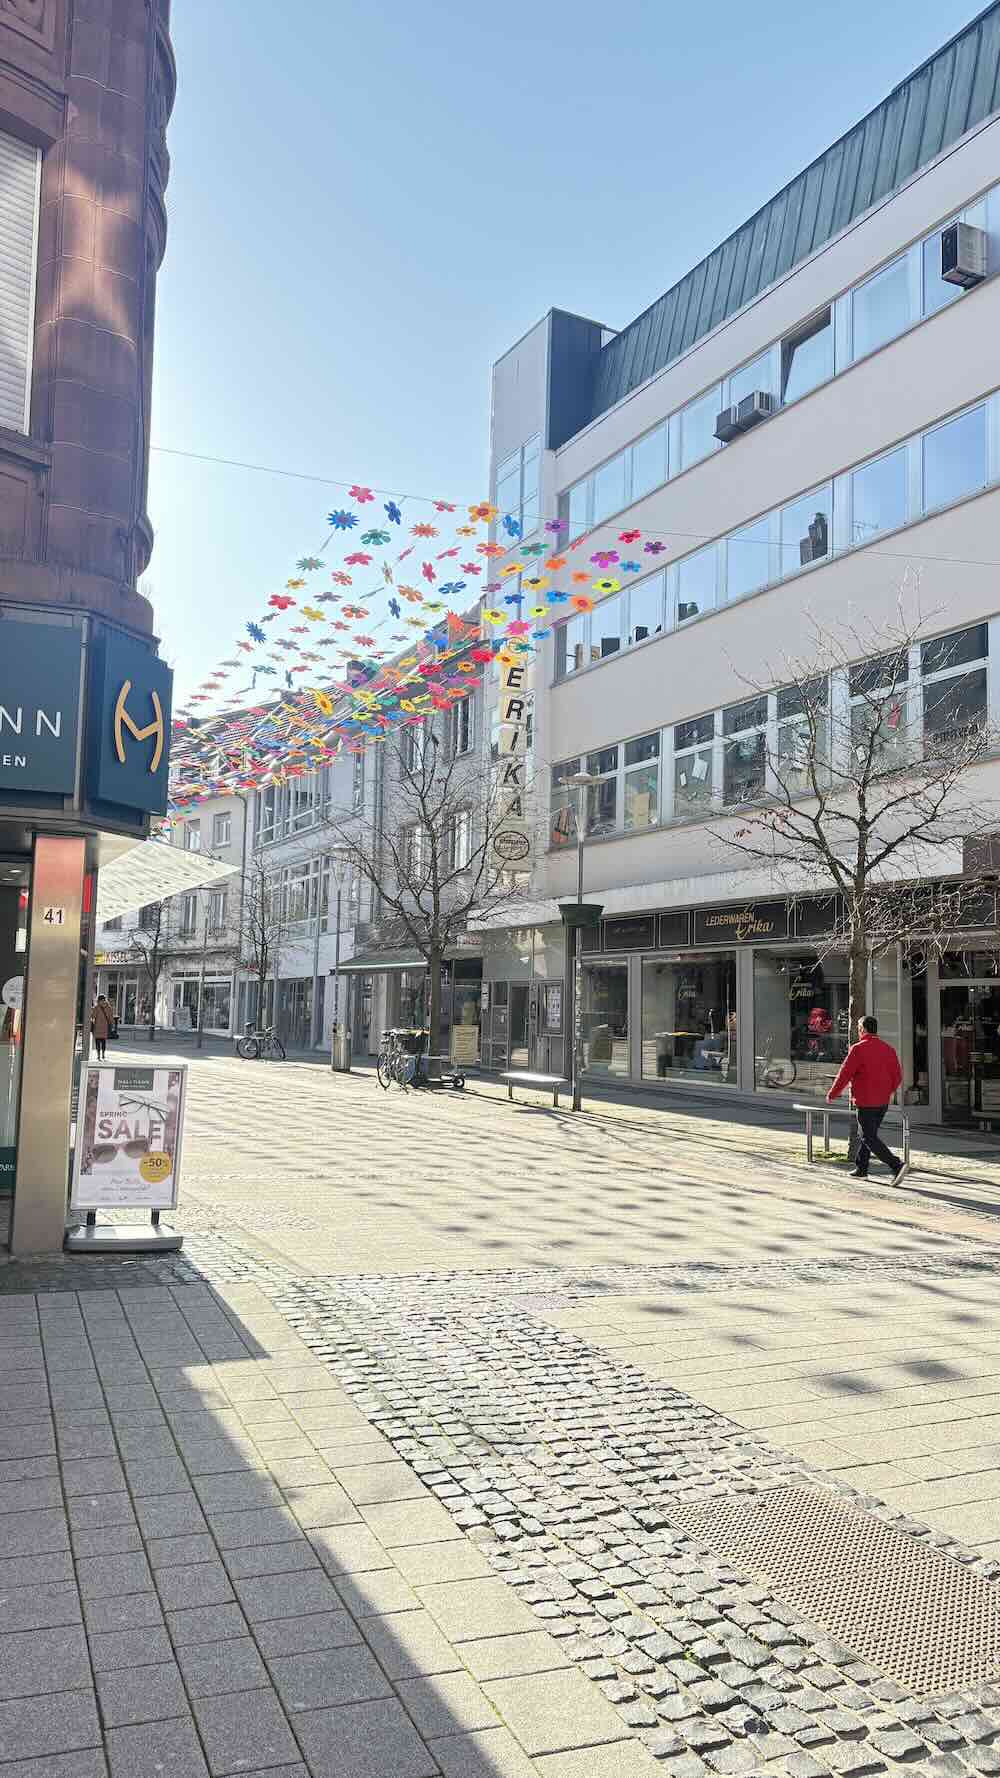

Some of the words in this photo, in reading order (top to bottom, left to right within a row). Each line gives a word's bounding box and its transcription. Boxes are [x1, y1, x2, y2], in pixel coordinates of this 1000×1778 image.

[44, 908, 63, 924] 41
[705, 911, 755, 927] LEDERWAREN
[736, 919, 774, 940] Erika
[98, 1119, 162, 1139] SALE
